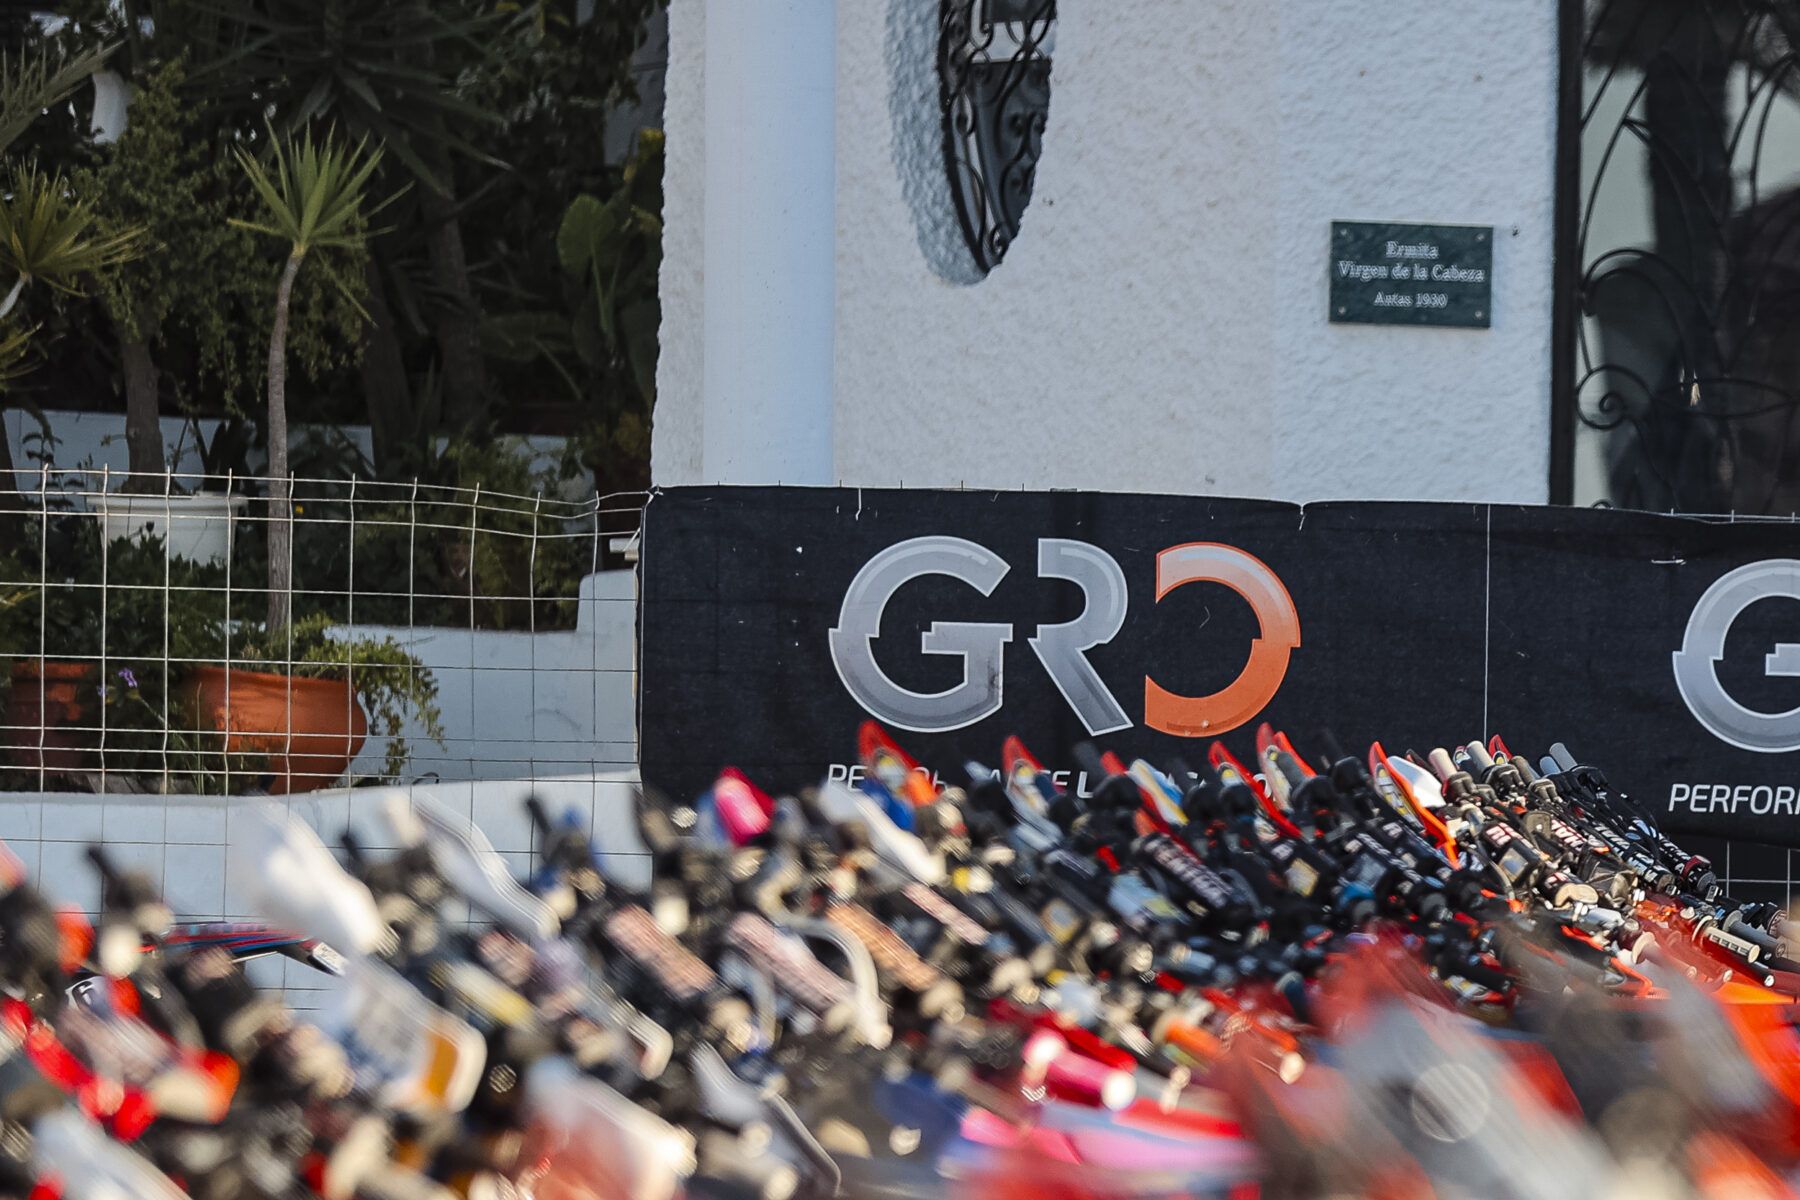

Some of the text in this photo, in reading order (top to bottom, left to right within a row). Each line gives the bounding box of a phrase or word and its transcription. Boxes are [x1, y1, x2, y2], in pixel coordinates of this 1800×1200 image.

[1386, 241, 1439, 259] Ermita
[1337, 261, 1485, 282] Virgen de la Cabeza
[1374, 291, 1448, 308] Antas 1930
[828, 535, 1301, 738] GRO
